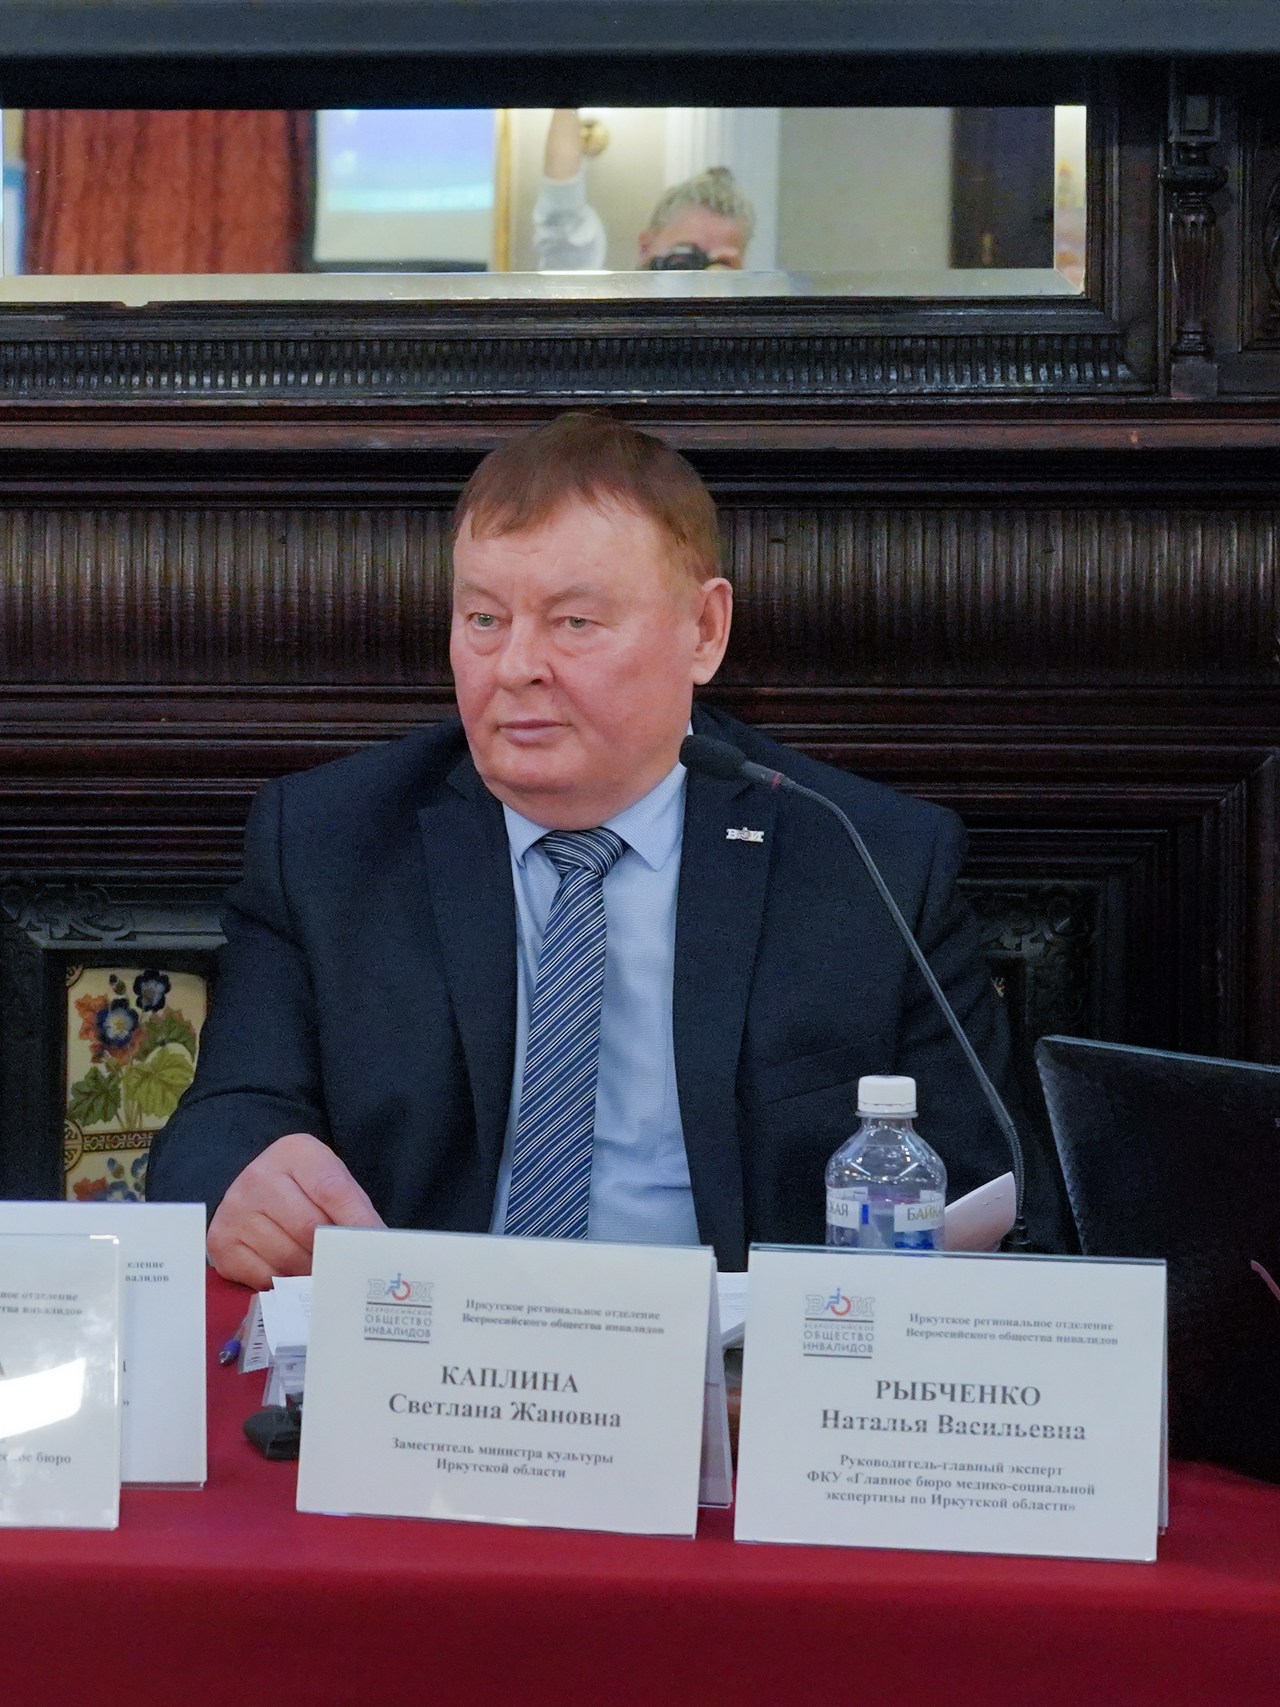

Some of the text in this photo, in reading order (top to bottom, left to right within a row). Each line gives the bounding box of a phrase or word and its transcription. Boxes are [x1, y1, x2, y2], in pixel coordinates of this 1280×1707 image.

[466, 1299, 660, 1320] Иркутское региональное отделение
[365, 1315, 432, 1327] ОБЩЕСТВО
[462, 1313, 664, 1334] Всероссийского общества инвалидов
[909, 1313, 1113, 1331] Иркутское региональное отделение
[364, 1327, 431, 1338] ИНВАЛИДОВ
[804, 1330, 875, 1341] ОБЩЕСТВО
[906, 1328, 1117, 1345] Всероссийского общества инвалидов
[803, 1341, 873, 1353] ИНВАЛИДОВ
[441, 1365, 579, 1394] КАПЛИНА
[876, 1379, 1041, 1406] РЫБЧЕНКО
[389, 1393, 621, 1427] Светлана Жановна
[821, 1410, 1086, 1441] Наталья Васильевна
[36, 1453, 71, 1465] бюро
[393, 1437, 613, 1464] Заместитель министра культуры
[437, 1458, 566, 1477] Иркутской области
[840, 1454, 1062, 1477] Руководитель-главный эксперт
[807, 1471, 1095, 1495] ФКУ «Главное бюро медико-социальной
[826, 1492, 1075, 1512] экспертизы по Иркутской области»
